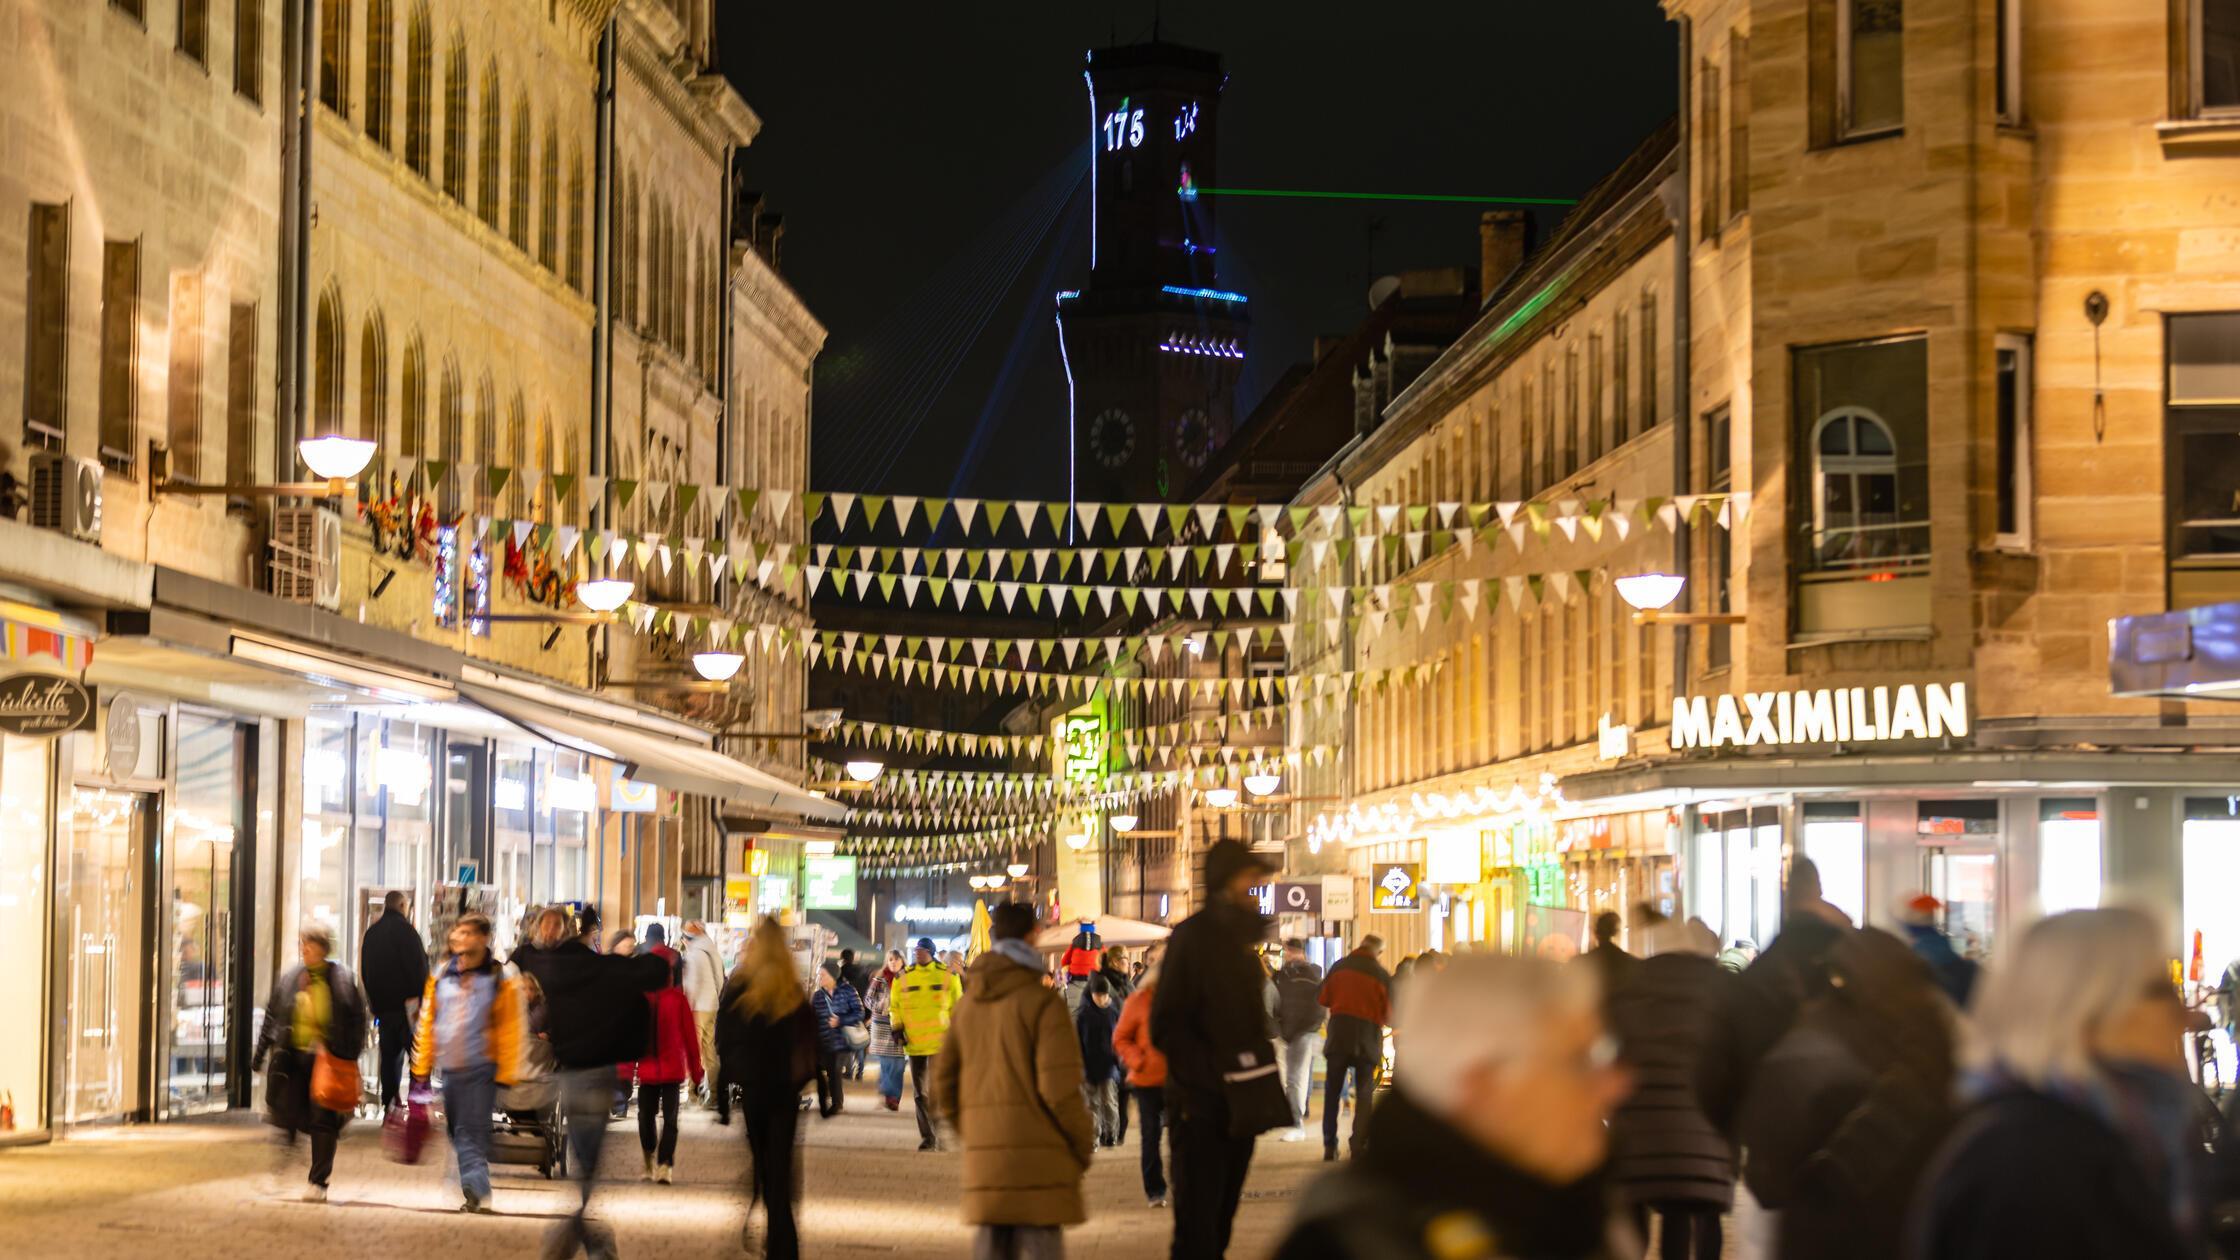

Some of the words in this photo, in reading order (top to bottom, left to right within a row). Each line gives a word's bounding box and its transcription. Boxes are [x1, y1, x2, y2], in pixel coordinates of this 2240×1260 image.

[1104, 109, 1144, 151] 175
[0, 680, 74, 712] iulietta
[1671, 682, 1968, 748] MAXIMILIAN
